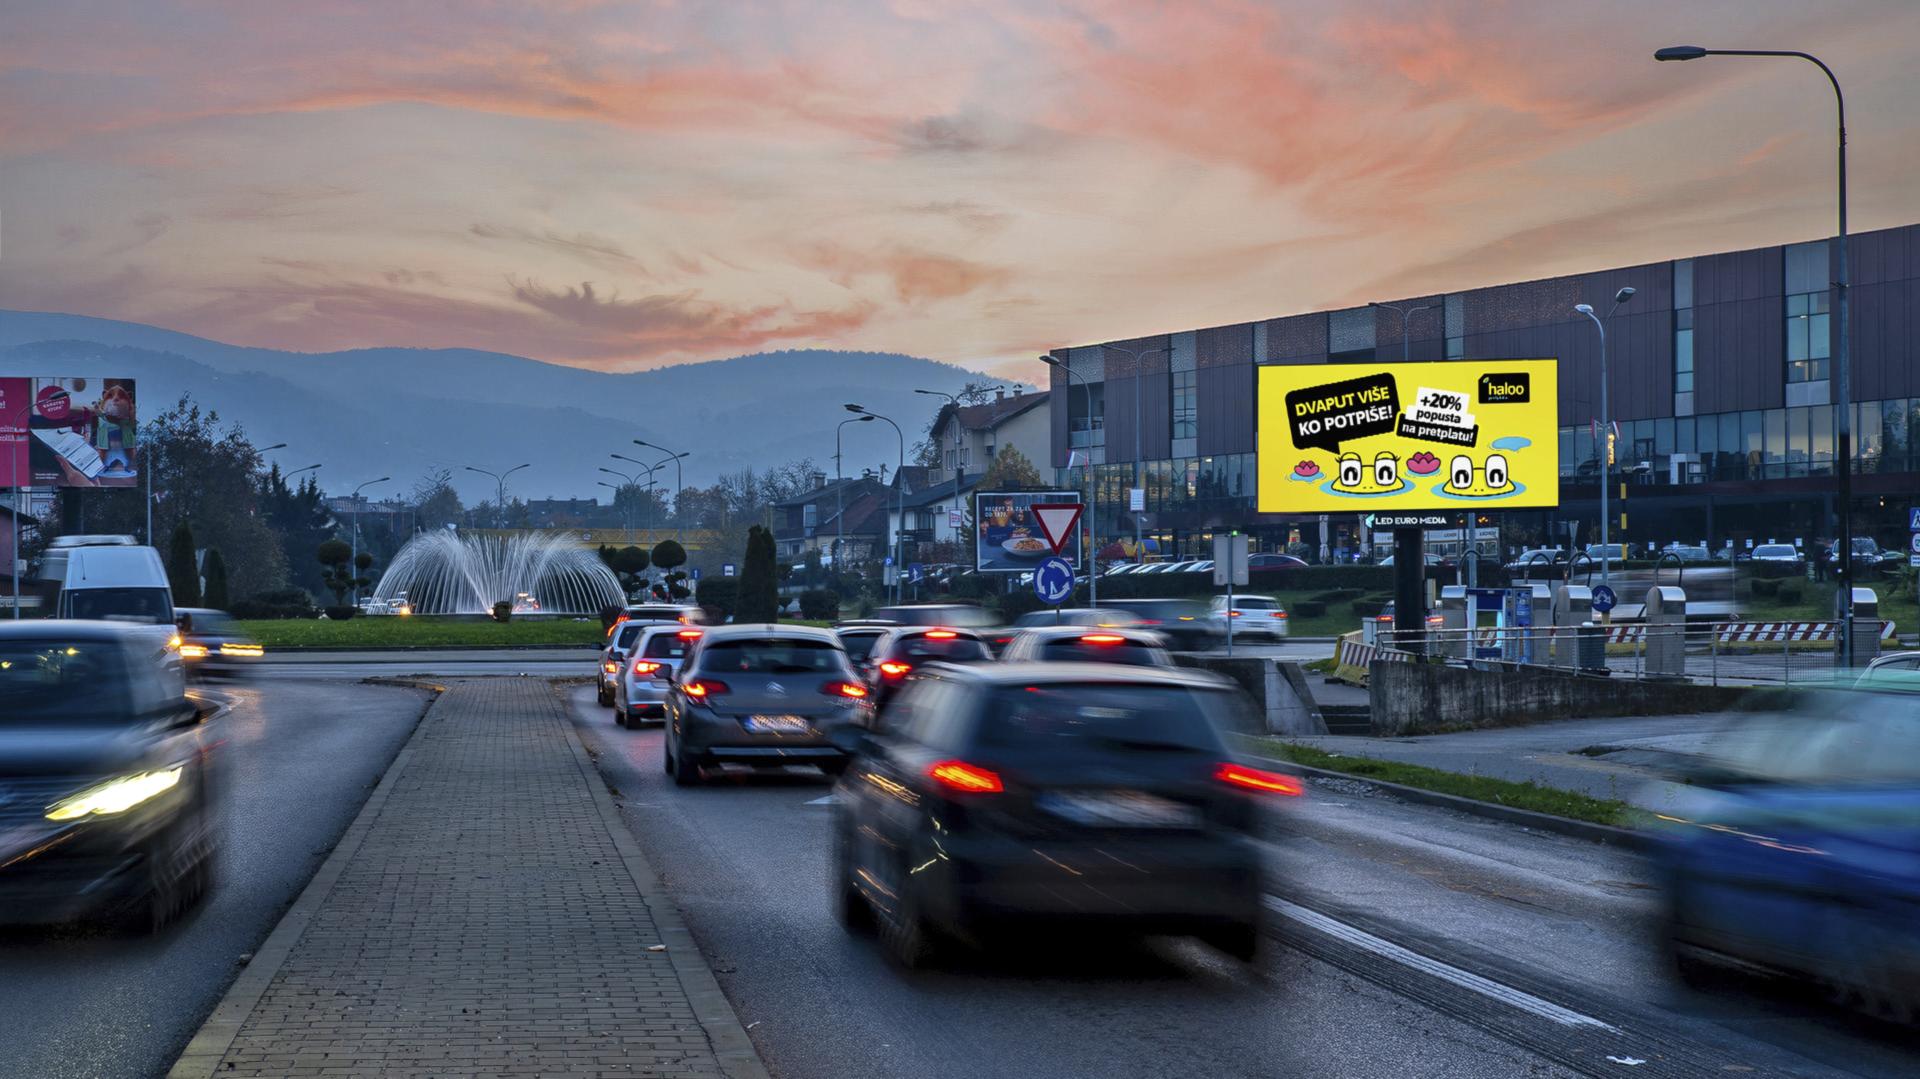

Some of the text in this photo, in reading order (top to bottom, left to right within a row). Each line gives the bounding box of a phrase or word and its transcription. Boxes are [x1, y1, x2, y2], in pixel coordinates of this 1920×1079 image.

[1488, 382, 1524, 395] haloo
[1295, 386, 1390, 417] DVAPUT VIŠE
[1420, 393, 1462, 411] +20%
[1298, 405, 1393, 436] KO POTPIŠE!
[1416, 409, 1462, 424] popusta
[1402, 423, 1474, 443] na pretplatu!
[1375, 517, 1447, 525] LED EURO MEDIA
